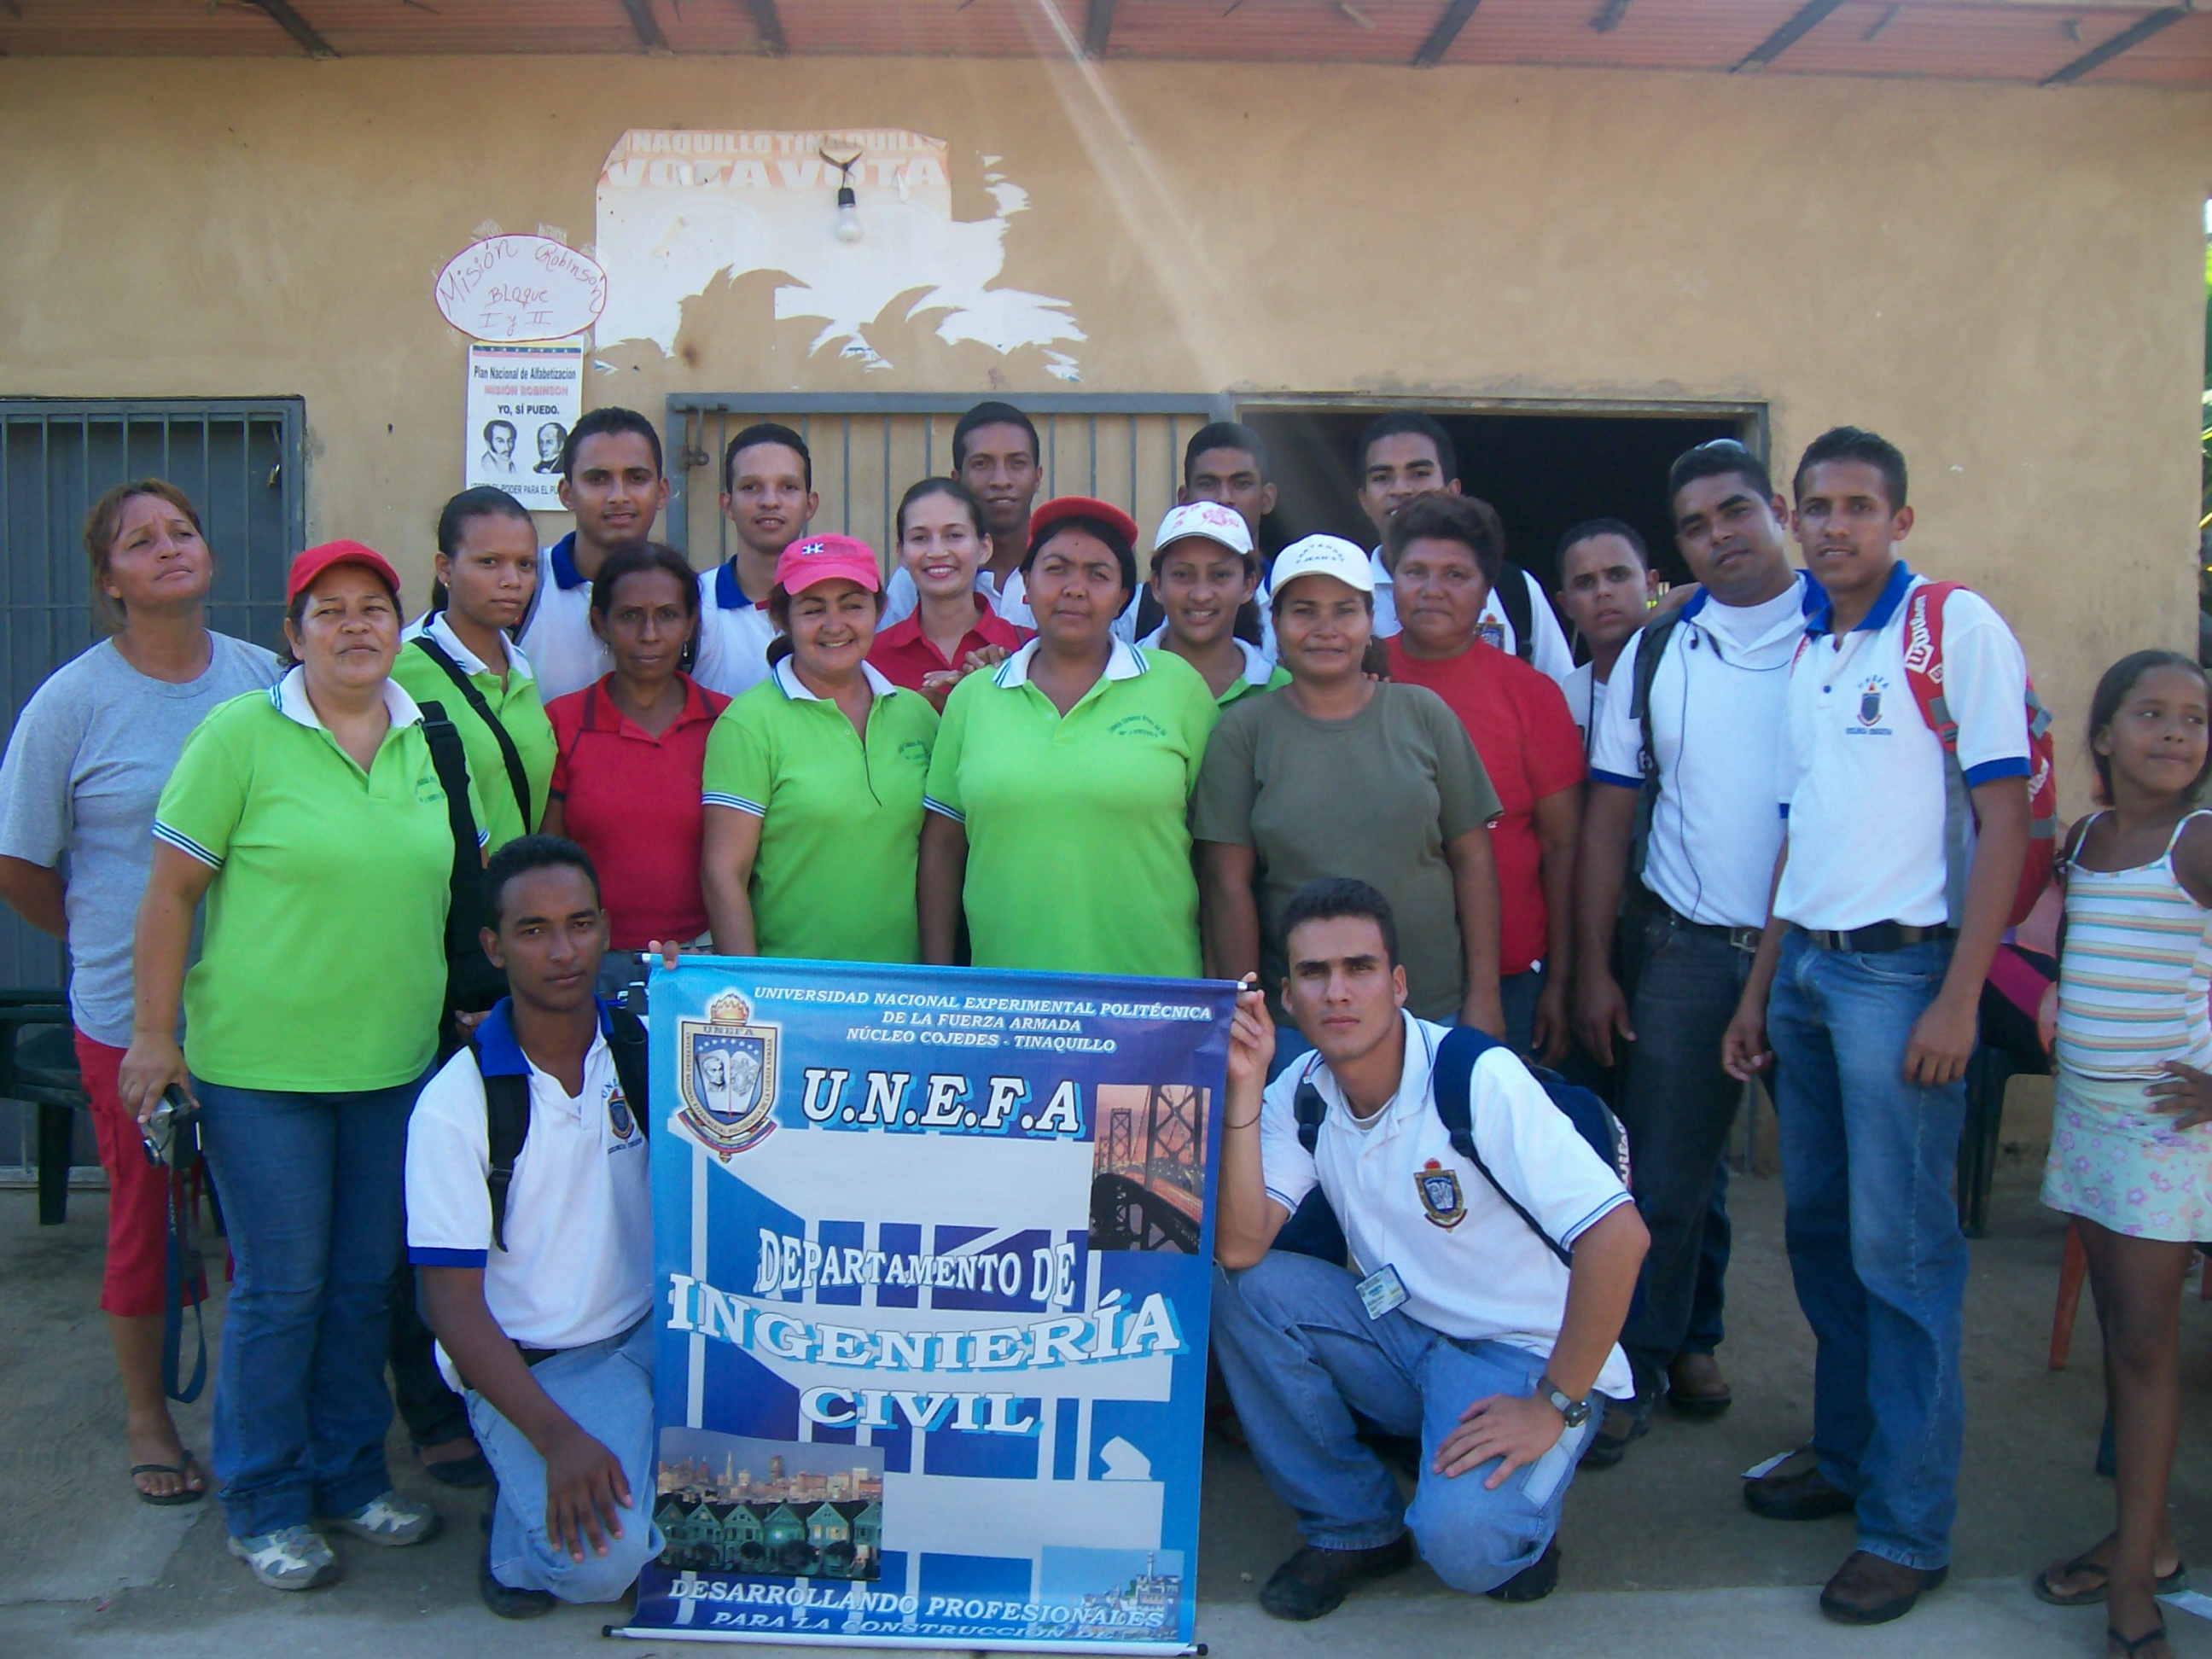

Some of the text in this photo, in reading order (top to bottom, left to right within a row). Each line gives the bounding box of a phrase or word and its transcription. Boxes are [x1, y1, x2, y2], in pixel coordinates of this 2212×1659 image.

[607, 157, 947, 188] VOTA VOTA
[524, 311, 554, 325] II
[474, 365, 577, 381] Plan Nacional de Alfabetización
[484, 383, 568, 397] MISIÓN ROBINSON
[498, 403, 560, 416] YO, SÍ PUEDO.
[523, 485, 539, 495] PARA
[540, 485, 549, 495] EL
[1905, 594, 1935, 674] Wilson
[754, 987, 1213, 1022] UNIVERSIDAD NACIONAL EXPERIMENTAL POLITÉCNICA
[702, 1025, 755, 1037] UNEFA
[882, 1010, 1082, 1033] DE LA FUERZA ARMADA
[846, 1025, 916, 1044] NÚCLEO
[920, 1030, 1000, 1048] COJEDES
[1013, 1033, 1118, 1054] TINAQUILLO
[802, 1068, 1082, 1133] U.N.E.F.A
[755, 1227, 1076, 1307] DEPARTAMENTO DE
[667, 1272, 1184, 1371] INGENIERÍA
[799, 1384, 1036, 1434] CIVIL
[667, 1578, 1165, 1629] DESARROLLANDO PROFESIONALES
[709, 1611, 784, 1628] PARA
[794, 1616, 830, 1630] LA
